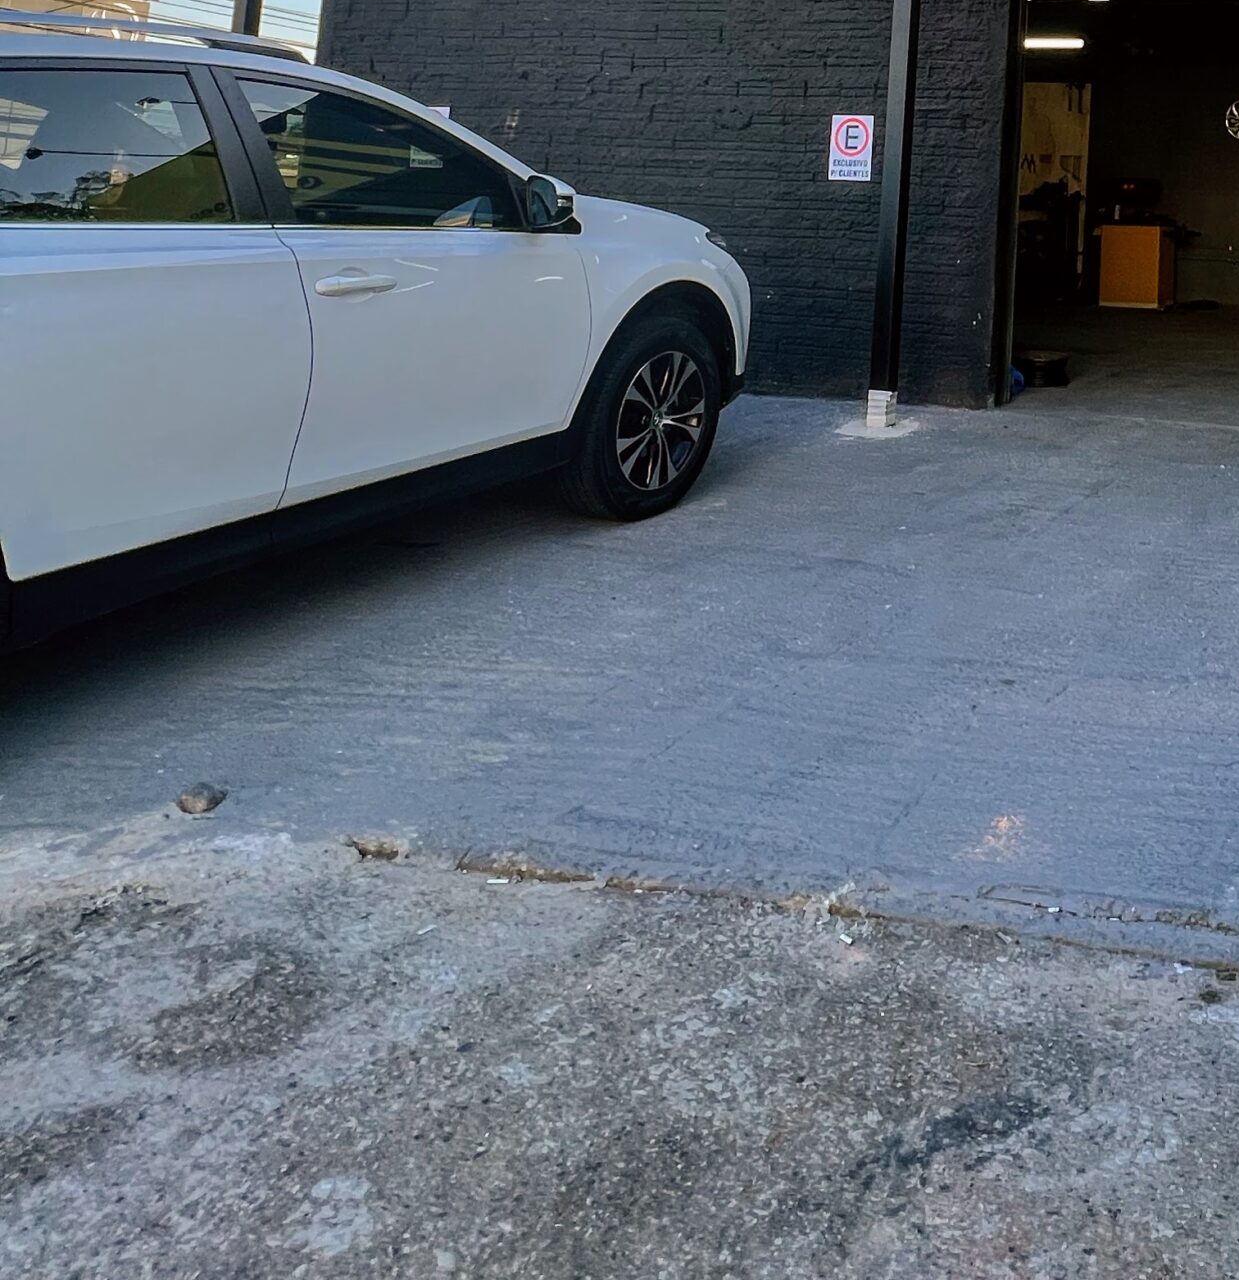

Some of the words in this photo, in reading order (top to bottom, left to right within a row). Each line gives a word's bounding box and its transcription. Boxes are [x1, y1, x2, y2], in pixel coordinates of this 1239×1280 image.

[845, 125, 859, 149] E
[833, 159, 868, 167] EXCLUSIVO
[839, 169, 869, 178] CLIENTES
